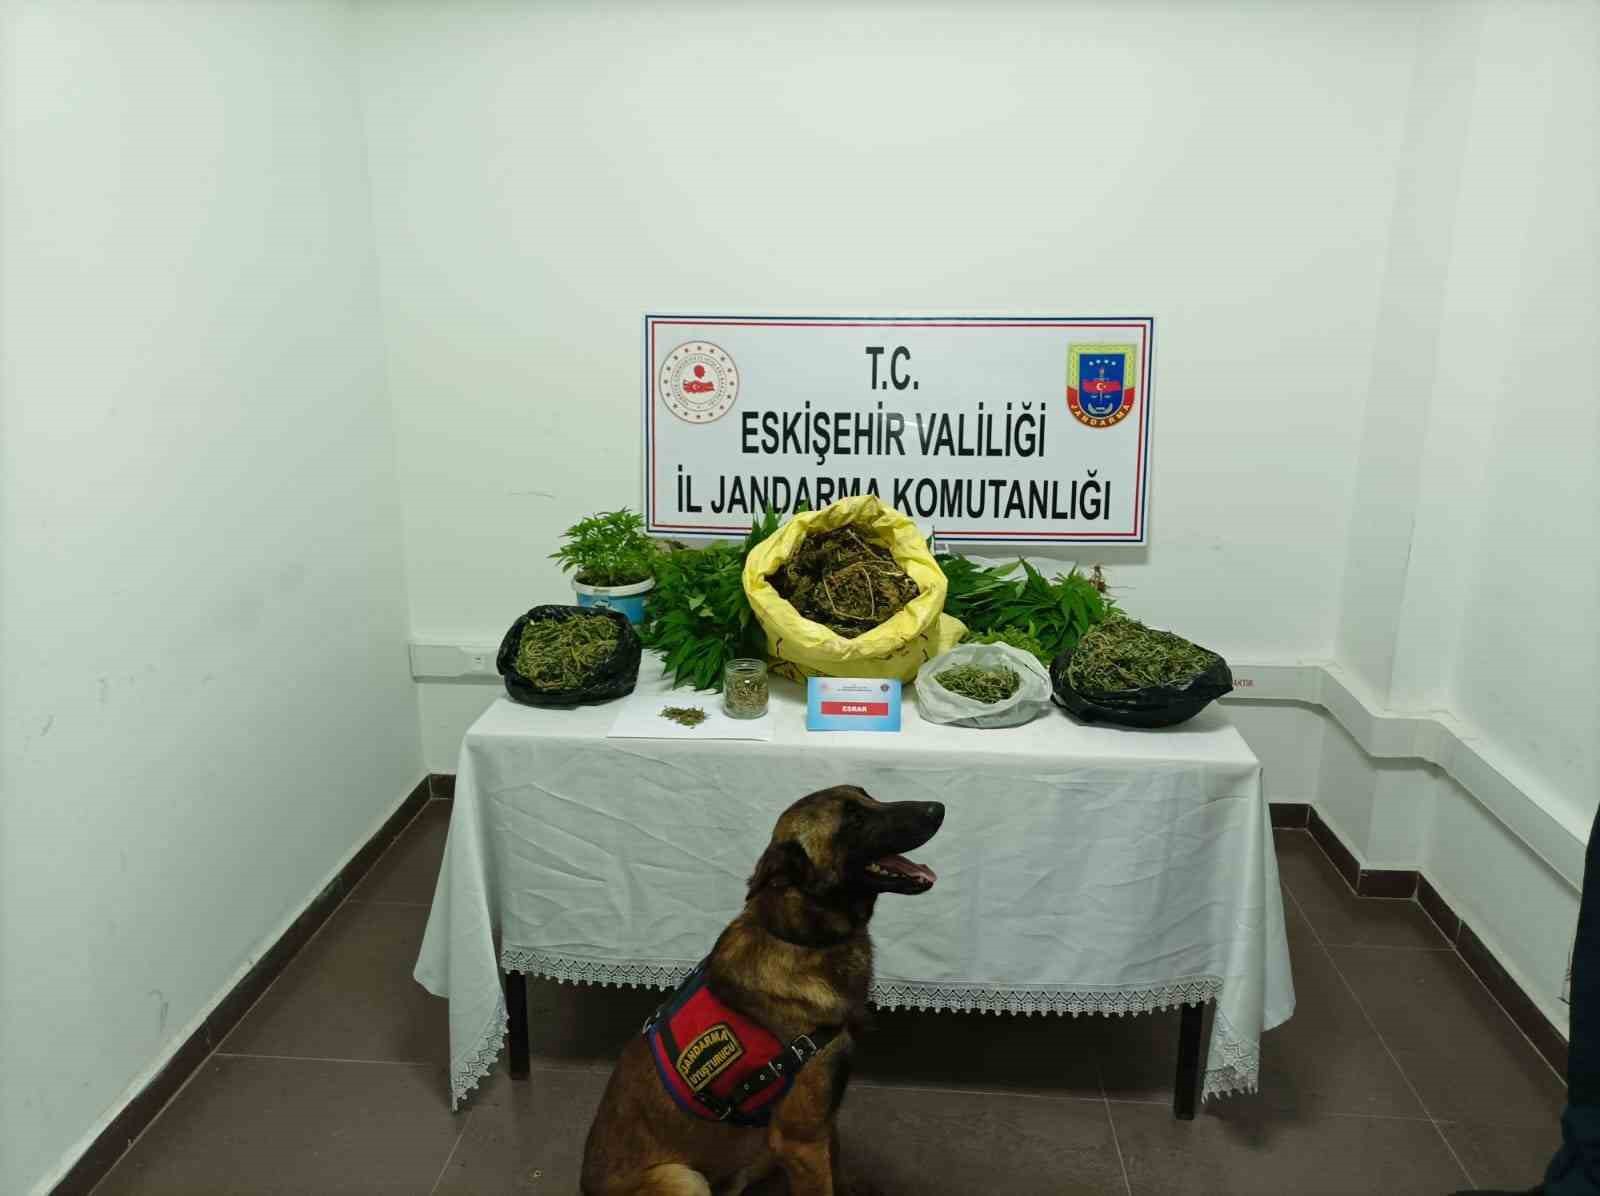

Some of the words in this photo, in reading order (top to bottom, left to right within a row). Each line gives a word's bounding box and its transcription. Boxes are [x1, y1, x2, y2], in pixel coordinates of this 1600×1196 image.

[865, 346, 919, 391] T.C.
[741, 400, 906, 466] ESKİŞEHİR
[916, 401, 1046, 458] VALİLİĞİ
[1070, 404, 1132, 427] JANDARMA
[677, 464, 703, 513] İL
[893, 469, 1111, 521] KOMUTANLIĞI
[680, 1029, 729, 1074] JANDARMA
